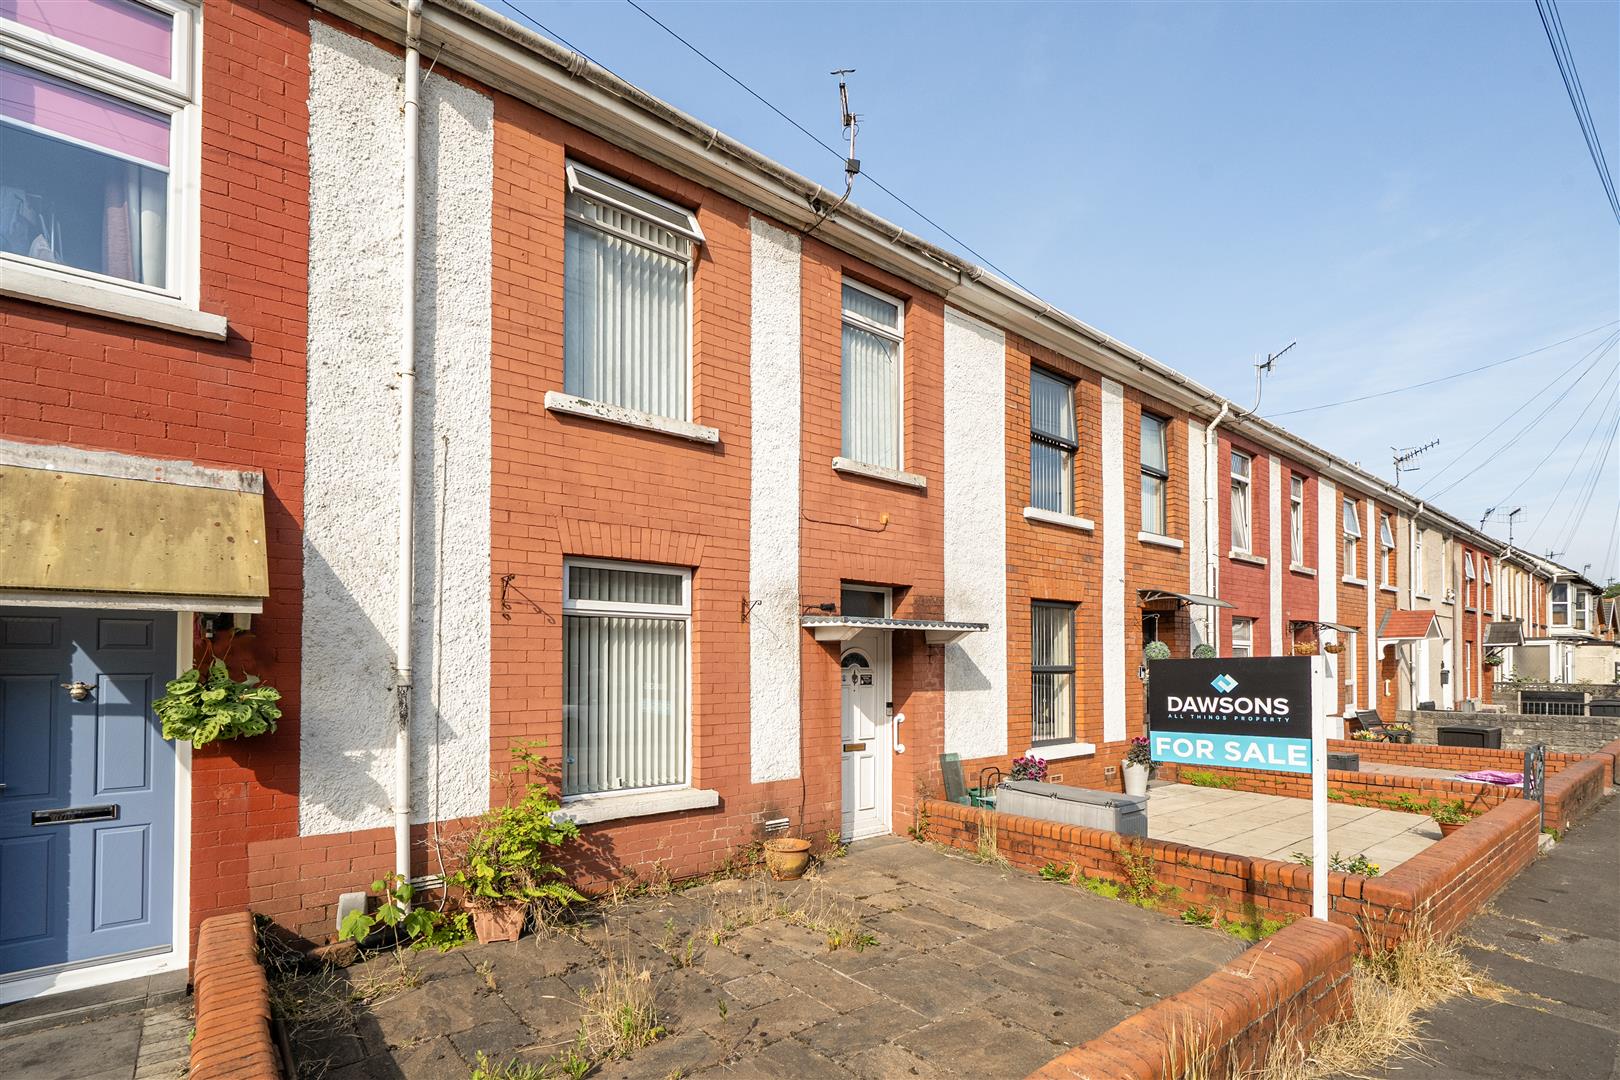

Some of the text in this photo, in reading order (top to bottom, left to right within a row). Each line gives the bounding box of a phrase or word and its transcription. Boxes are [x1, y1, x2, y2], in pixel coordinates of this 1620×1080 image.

[1167, 696, 1290, 715] DAWSONS
[1234, 715, 1290, 723] PROPERTY
[1156, 737, 1308, 767] FOR SALE
